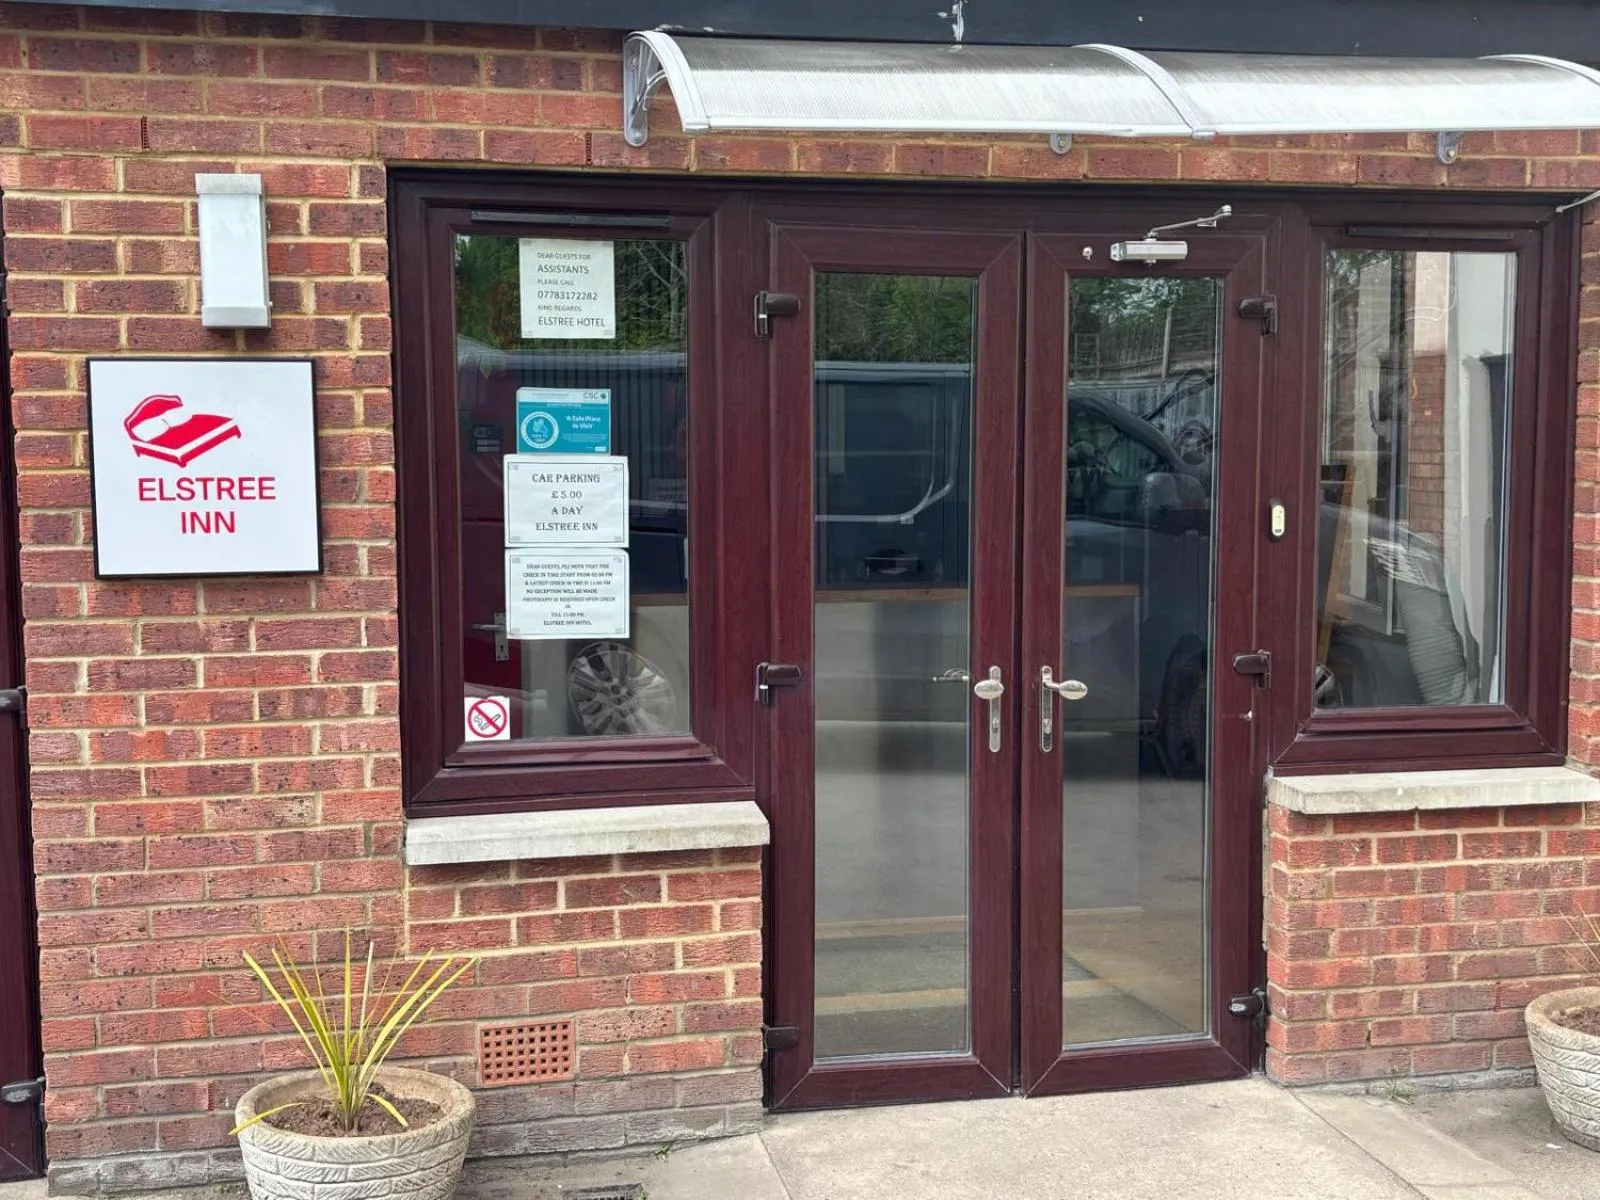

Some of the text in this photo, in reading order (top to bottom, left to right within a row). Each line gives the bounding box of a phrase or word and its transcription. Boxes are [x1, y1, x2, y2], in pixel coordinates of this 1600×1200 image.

[537, 264, 589, 274] ASSISTANTS
[537, 290, 598, 301] 07783172282
[538, 317, 606, 327] ELSTREE HOTEL
[532, 473, 601, 483] CAR PARKING
[138, 477, 276, 501] ELSTREE
[551, 490, 583, 499] £ 5.00
[551, 505, 583, 515] A DAY
[181, 511, 236, 534] INN
[536, 522, 598, 531] ELSTREE INN
